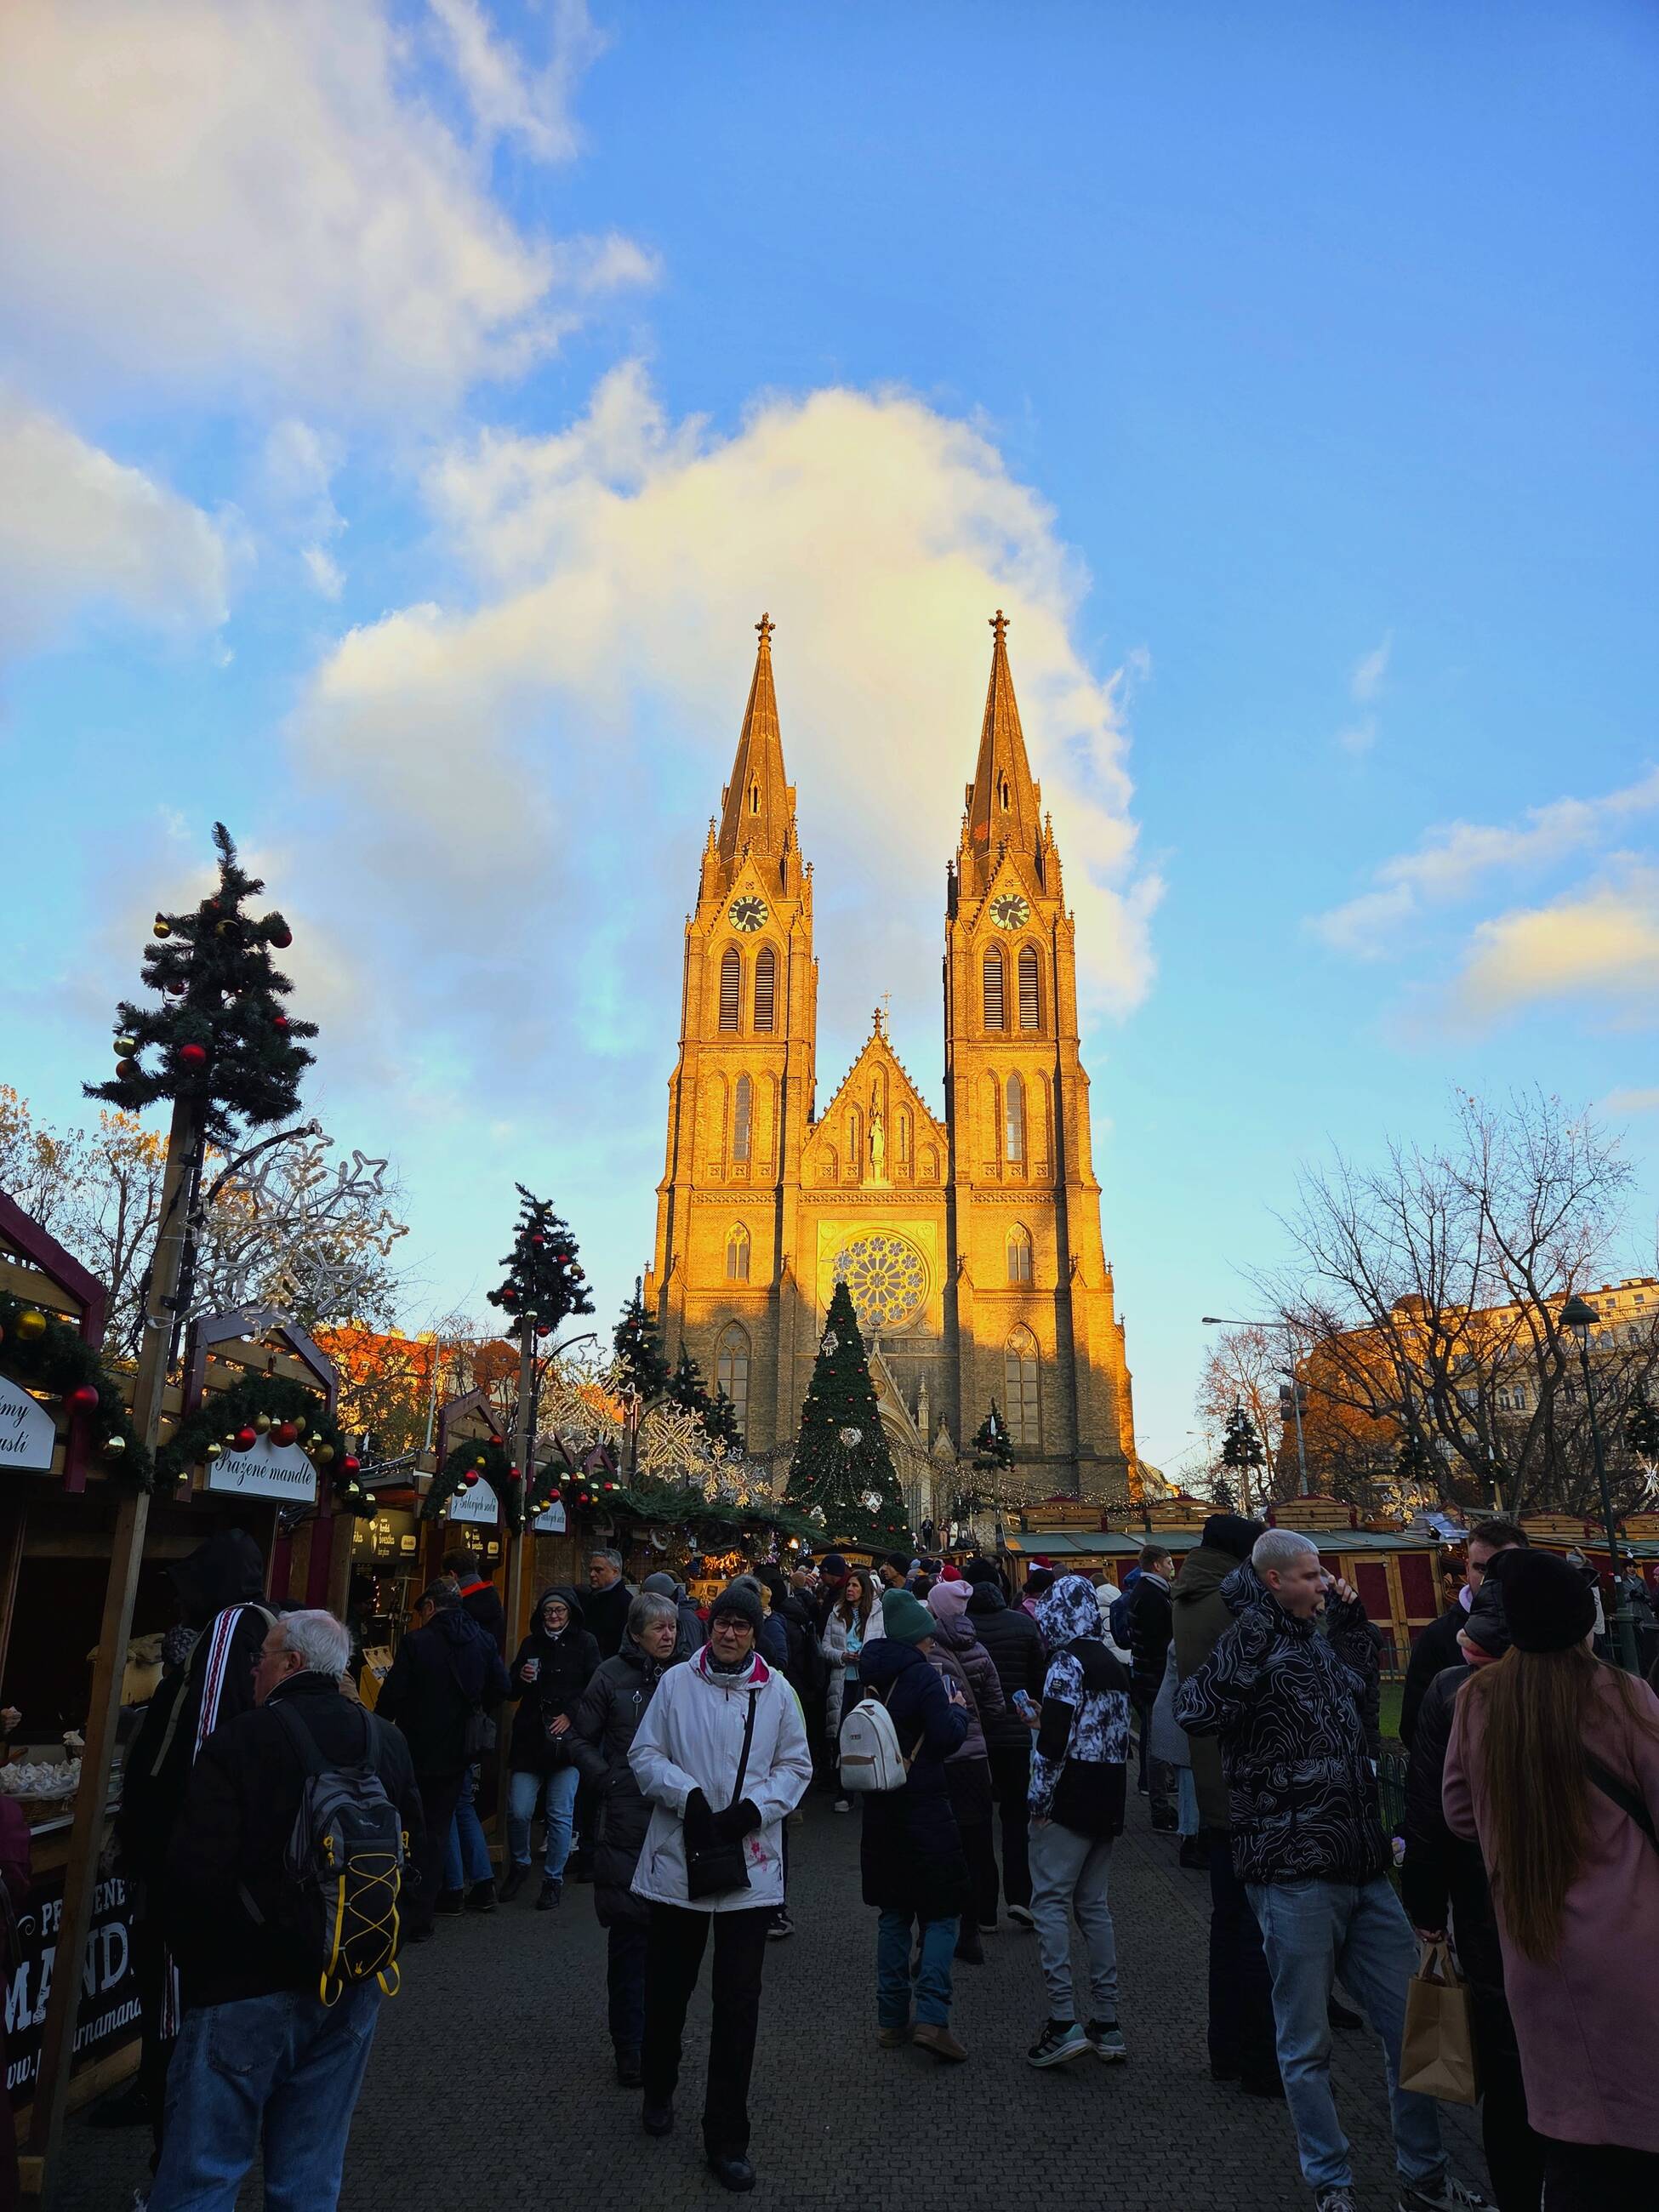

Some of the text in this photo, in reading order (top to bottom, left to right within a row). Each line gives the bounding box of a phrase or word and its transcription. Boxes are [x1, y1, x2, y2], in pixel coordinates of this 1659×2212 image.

[0, 1394, 31, 1428] my
[215, 1447, 313, 1486] Pražené mandle
